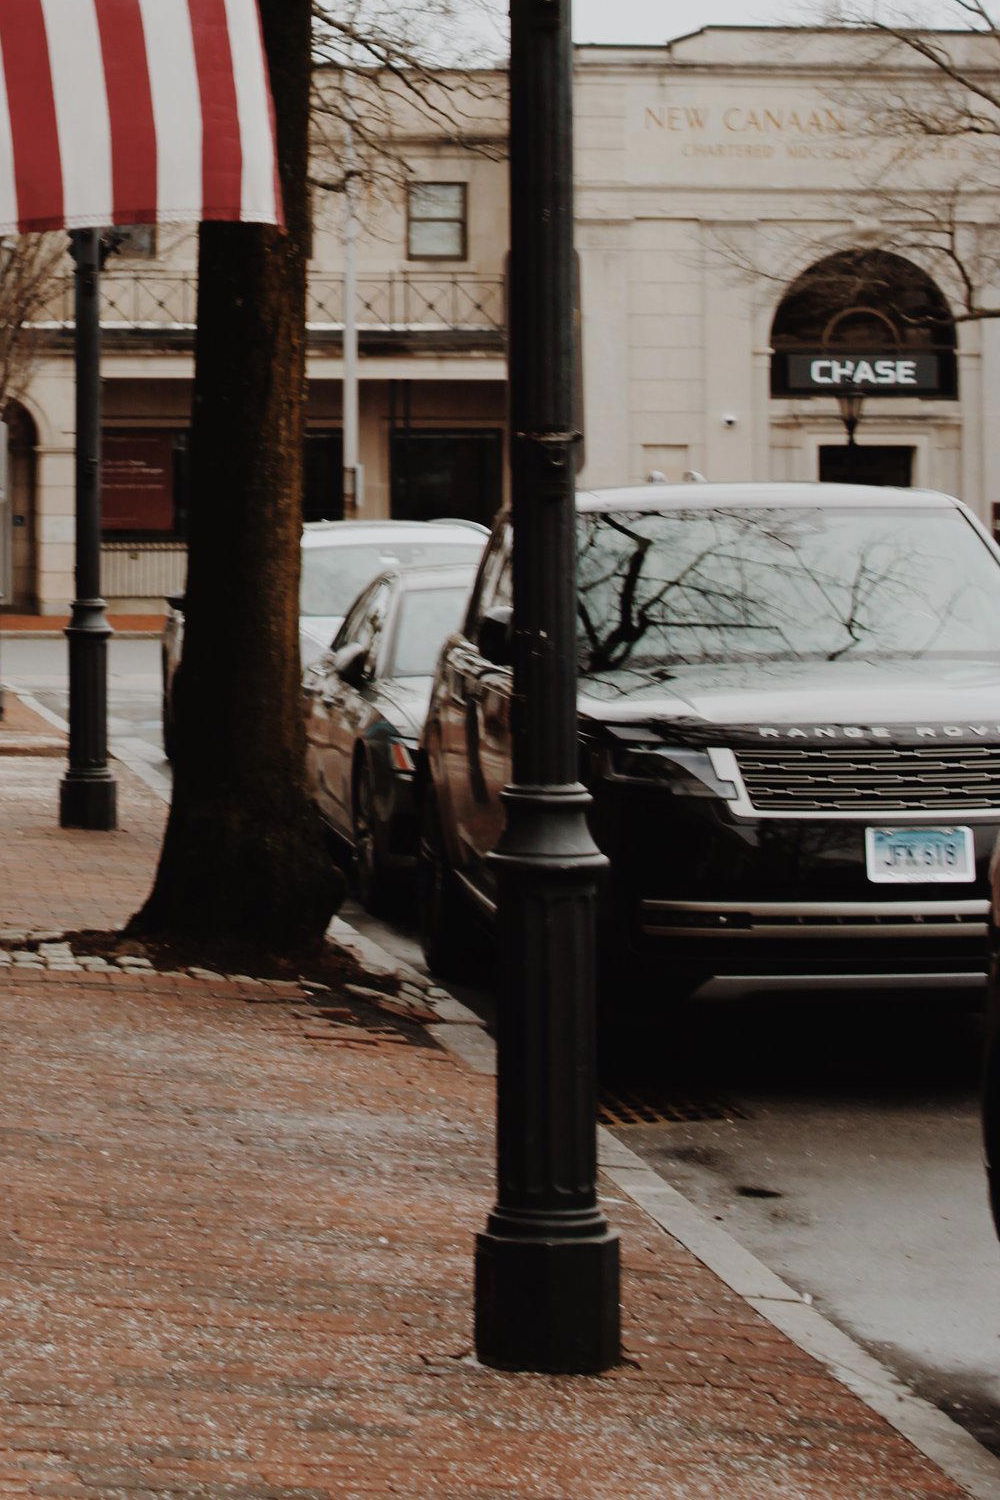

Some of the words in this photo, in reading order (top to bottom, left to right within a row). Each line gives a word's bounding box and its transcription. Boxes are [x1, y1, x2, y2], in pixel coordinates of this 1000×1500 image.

[644, 106, 708, 130] NEW
[723, 106, 849, 132] CANAAN
[810, 359, 918, 384] CHASE
[758, 726, 891, 739] RANGE
[915, 724, 1000, 738] ROV
